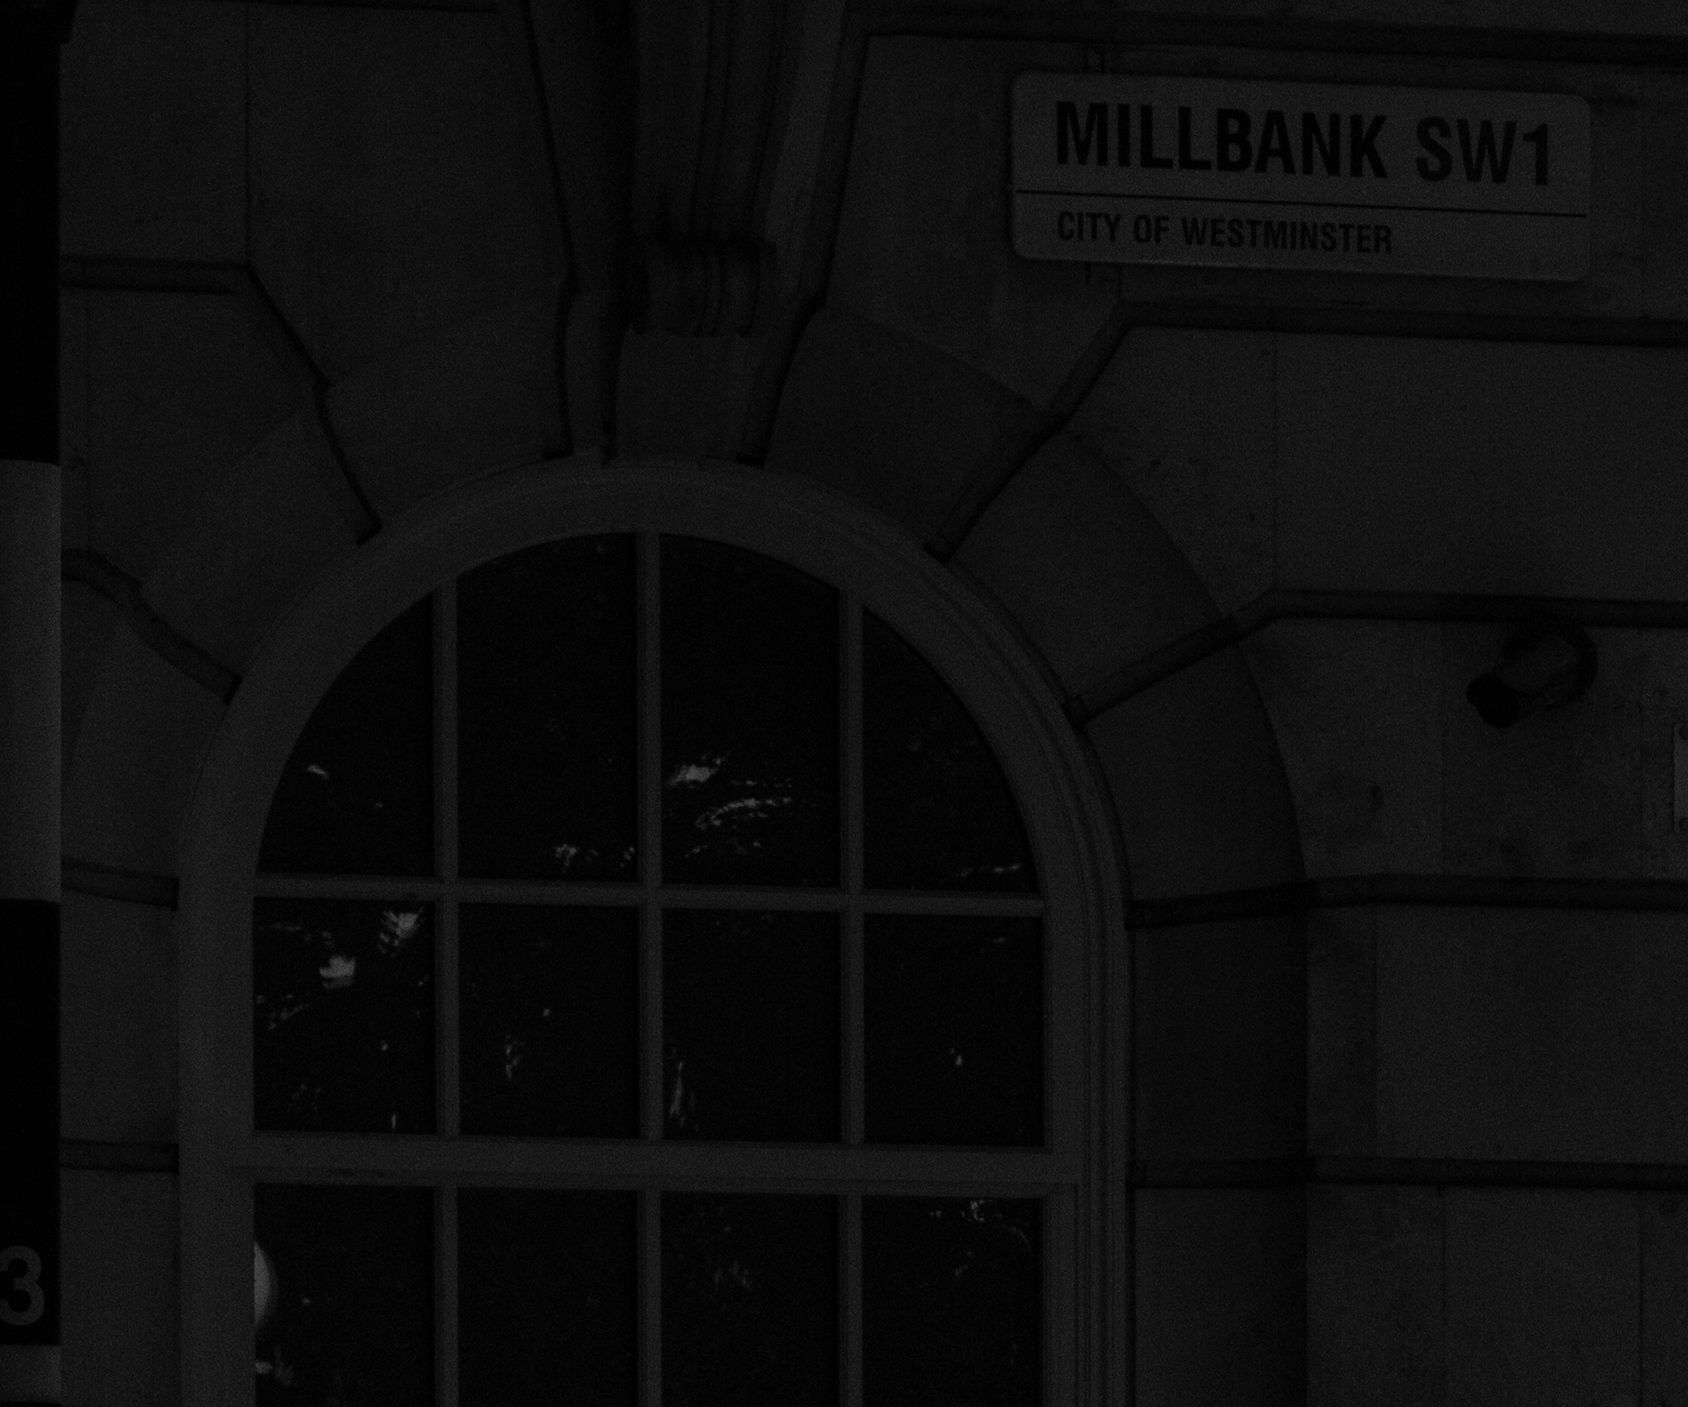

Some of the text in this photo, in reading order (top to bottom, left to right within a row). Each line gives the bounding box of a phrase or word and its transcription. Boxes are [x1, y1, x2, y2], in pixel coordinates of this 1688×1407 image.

[1055, 101, 1550, 186] MILLBANK SW1
[1057, 210, 1394, 255] CITY OF WESTMINSTER
[0, 1245, 46, 1327] 3
